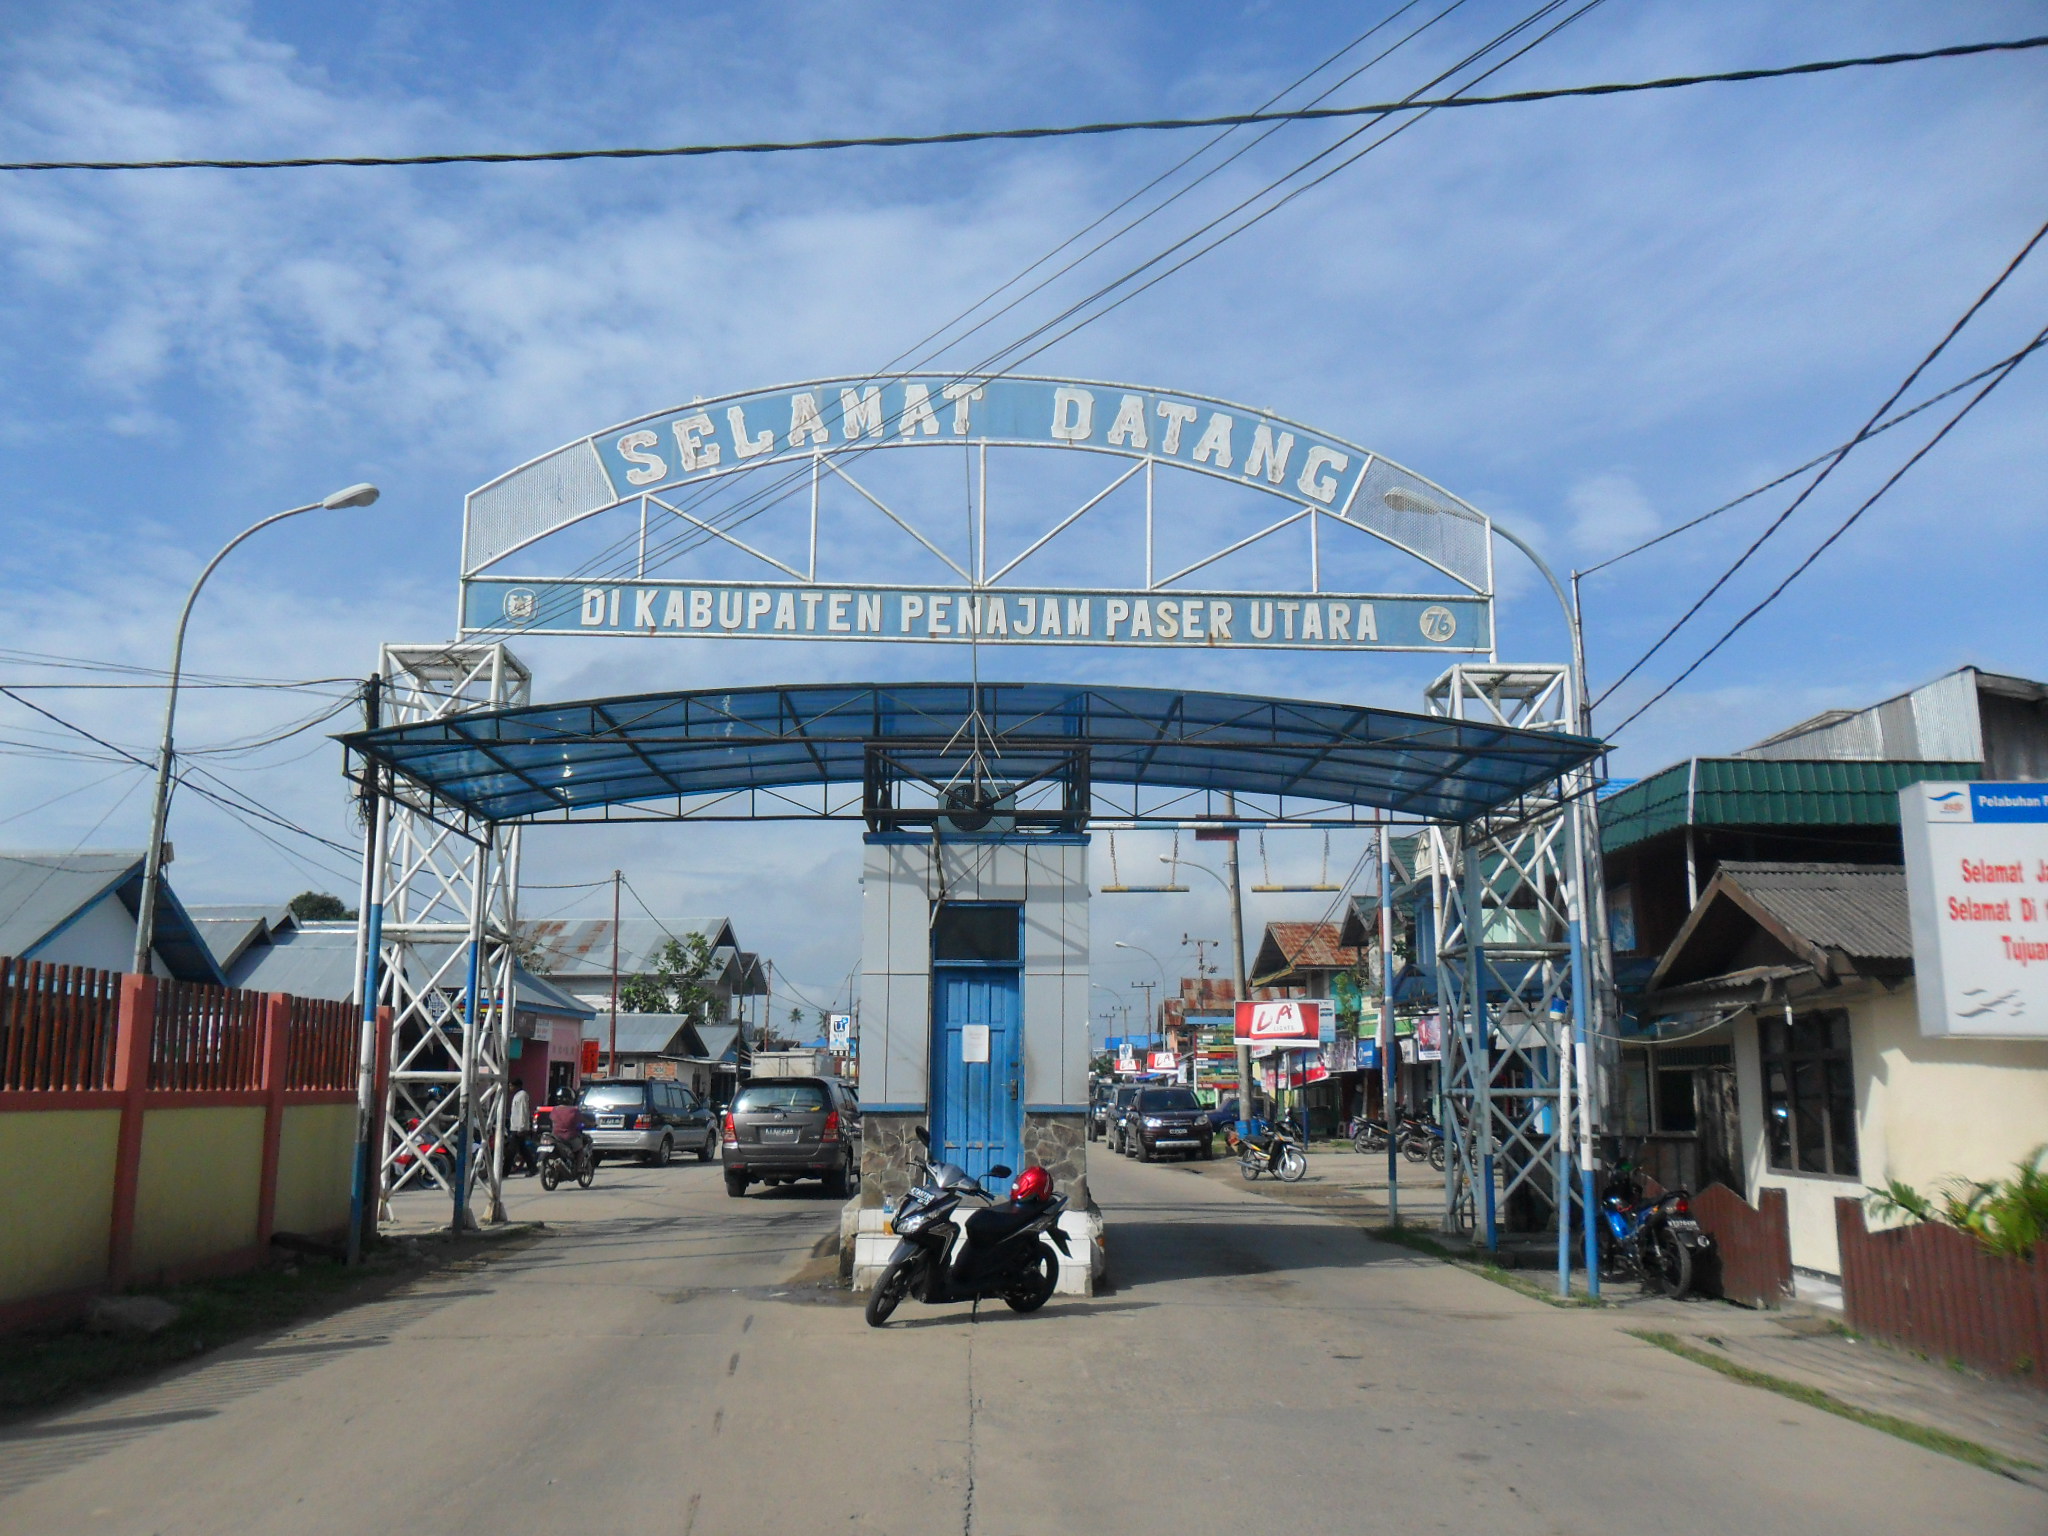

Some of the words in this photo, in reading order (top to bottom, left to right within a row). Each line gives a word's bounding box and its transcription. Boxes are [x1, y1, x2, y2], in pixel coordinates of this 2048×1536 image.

[617, 382, 983, 486] SELAMAT
[1051, 387, 1349, 504] DATANG
[581, 588, 619, 627] DI
[635, 590, 881, 633] KABUPATEN
[902, 594, 1091, 636] PENAJAM
[1106, 599, 1233, 639] PASER
[1251, 601, 1378, 641] UTARA
[1426, 613, 1451, 635] 76
[1979, 795, 2041, 807] Pelabuhan
[1961, 859, 2024, 883] Selamat
[1948, 896, 2011, 921] Selamat
[2020, 897, 2038, 922] Di
